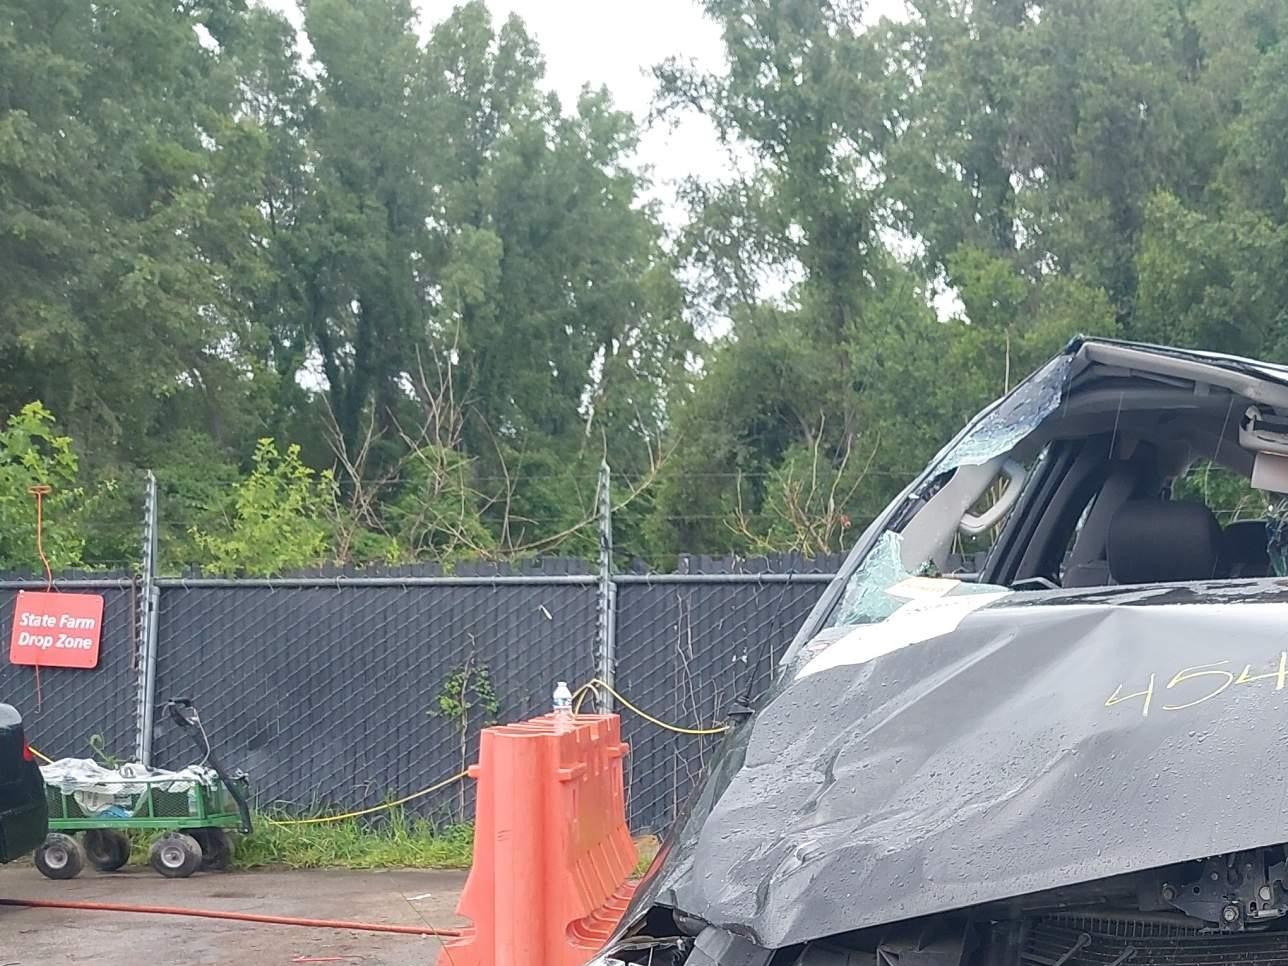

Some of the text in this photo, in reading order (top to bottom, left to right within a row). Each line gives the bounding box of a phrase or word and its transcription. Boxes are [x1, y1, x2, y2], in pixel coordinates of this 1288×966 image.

[20, 612, 95, 630] State Farm
[18, 632, 92, 651] Drop Zone
